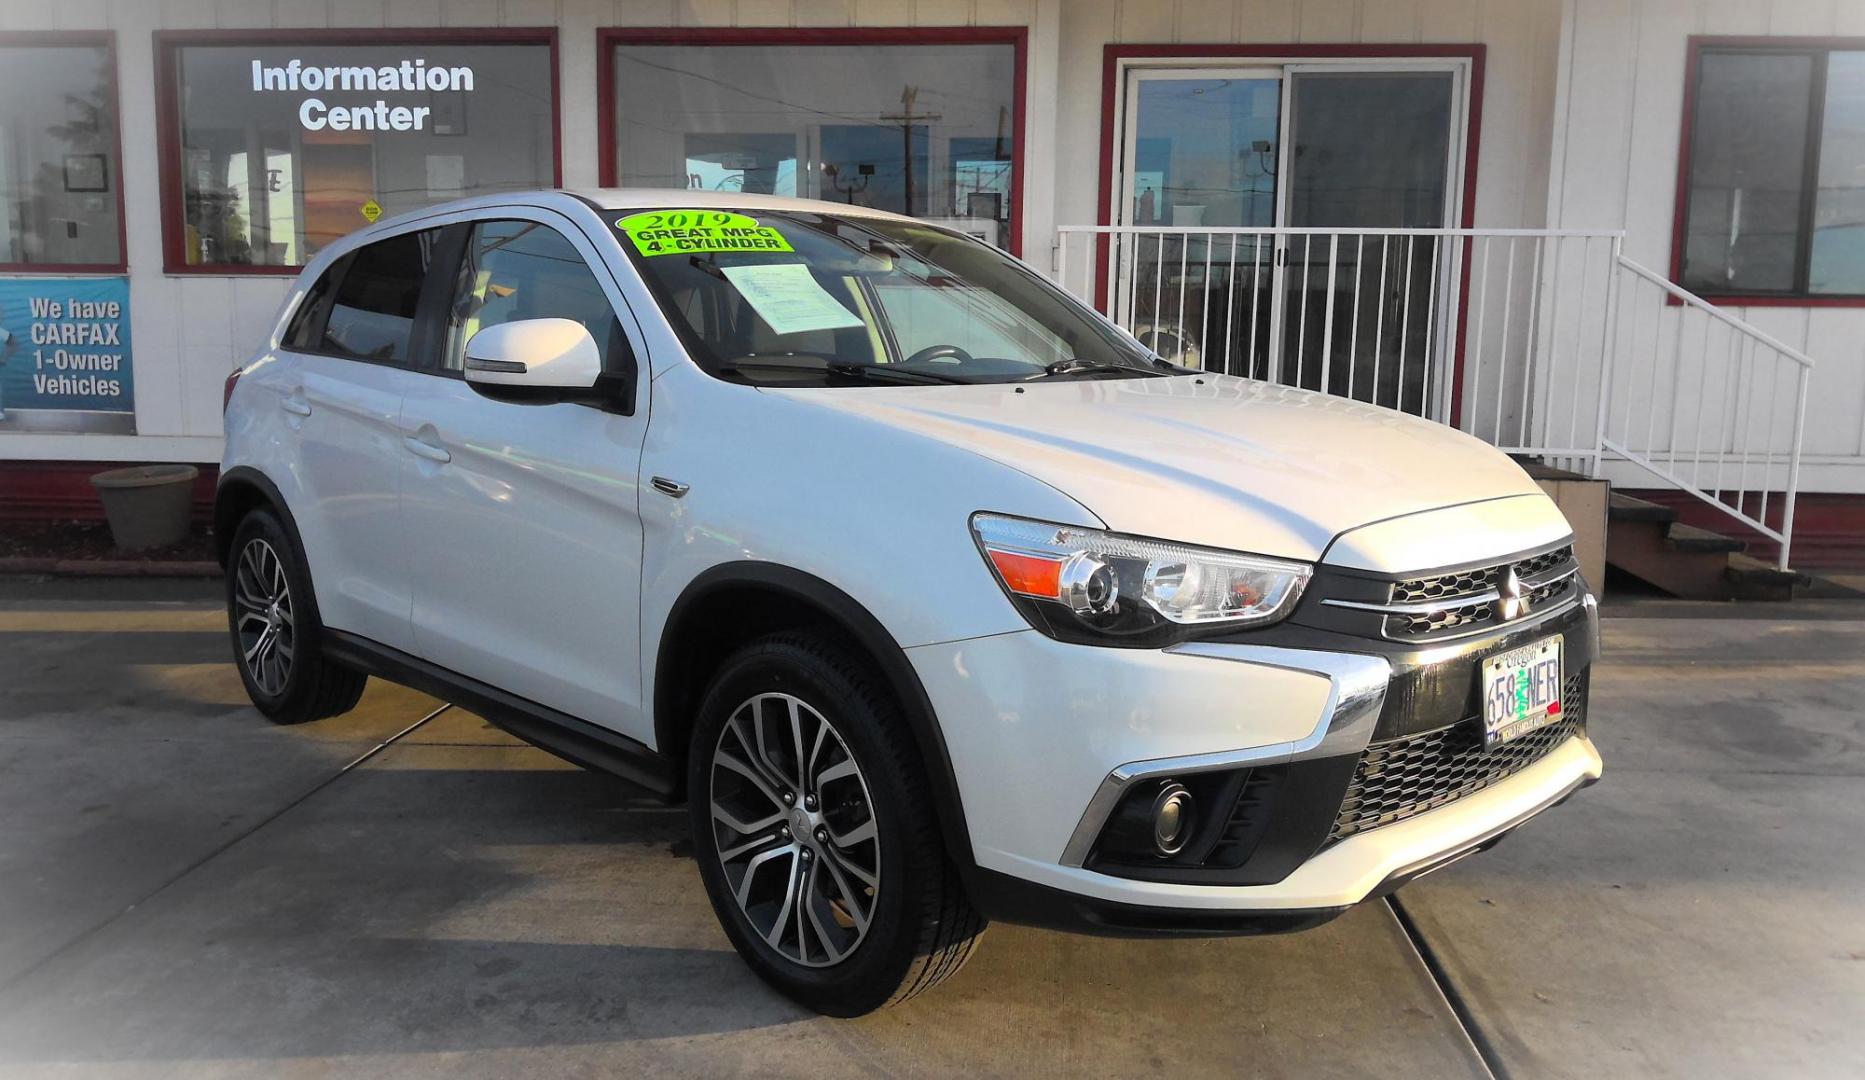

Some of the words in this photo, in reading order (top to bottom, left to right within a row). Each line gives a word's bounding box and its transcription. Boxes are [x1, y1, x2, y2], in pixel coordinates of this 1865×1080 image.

[252, 59, 474, 91] Information
[299, 98, 430, 131] Center
[645, 213, 731, 229] 2019
[636, 228, 713, 242] GREAT
[722, 227, 774, 239] MPG
[29, 298, 62, 319] We
[69, 298, 120, 319] have
[31, 322, 120, 346] CARFAX
[33, 348, 122, 371] 1-Owner
[33, 374, 120, 396] Vehicles
[1487, 673, 1516, 727] 658
[1526, 659, 1558, 711] NER
